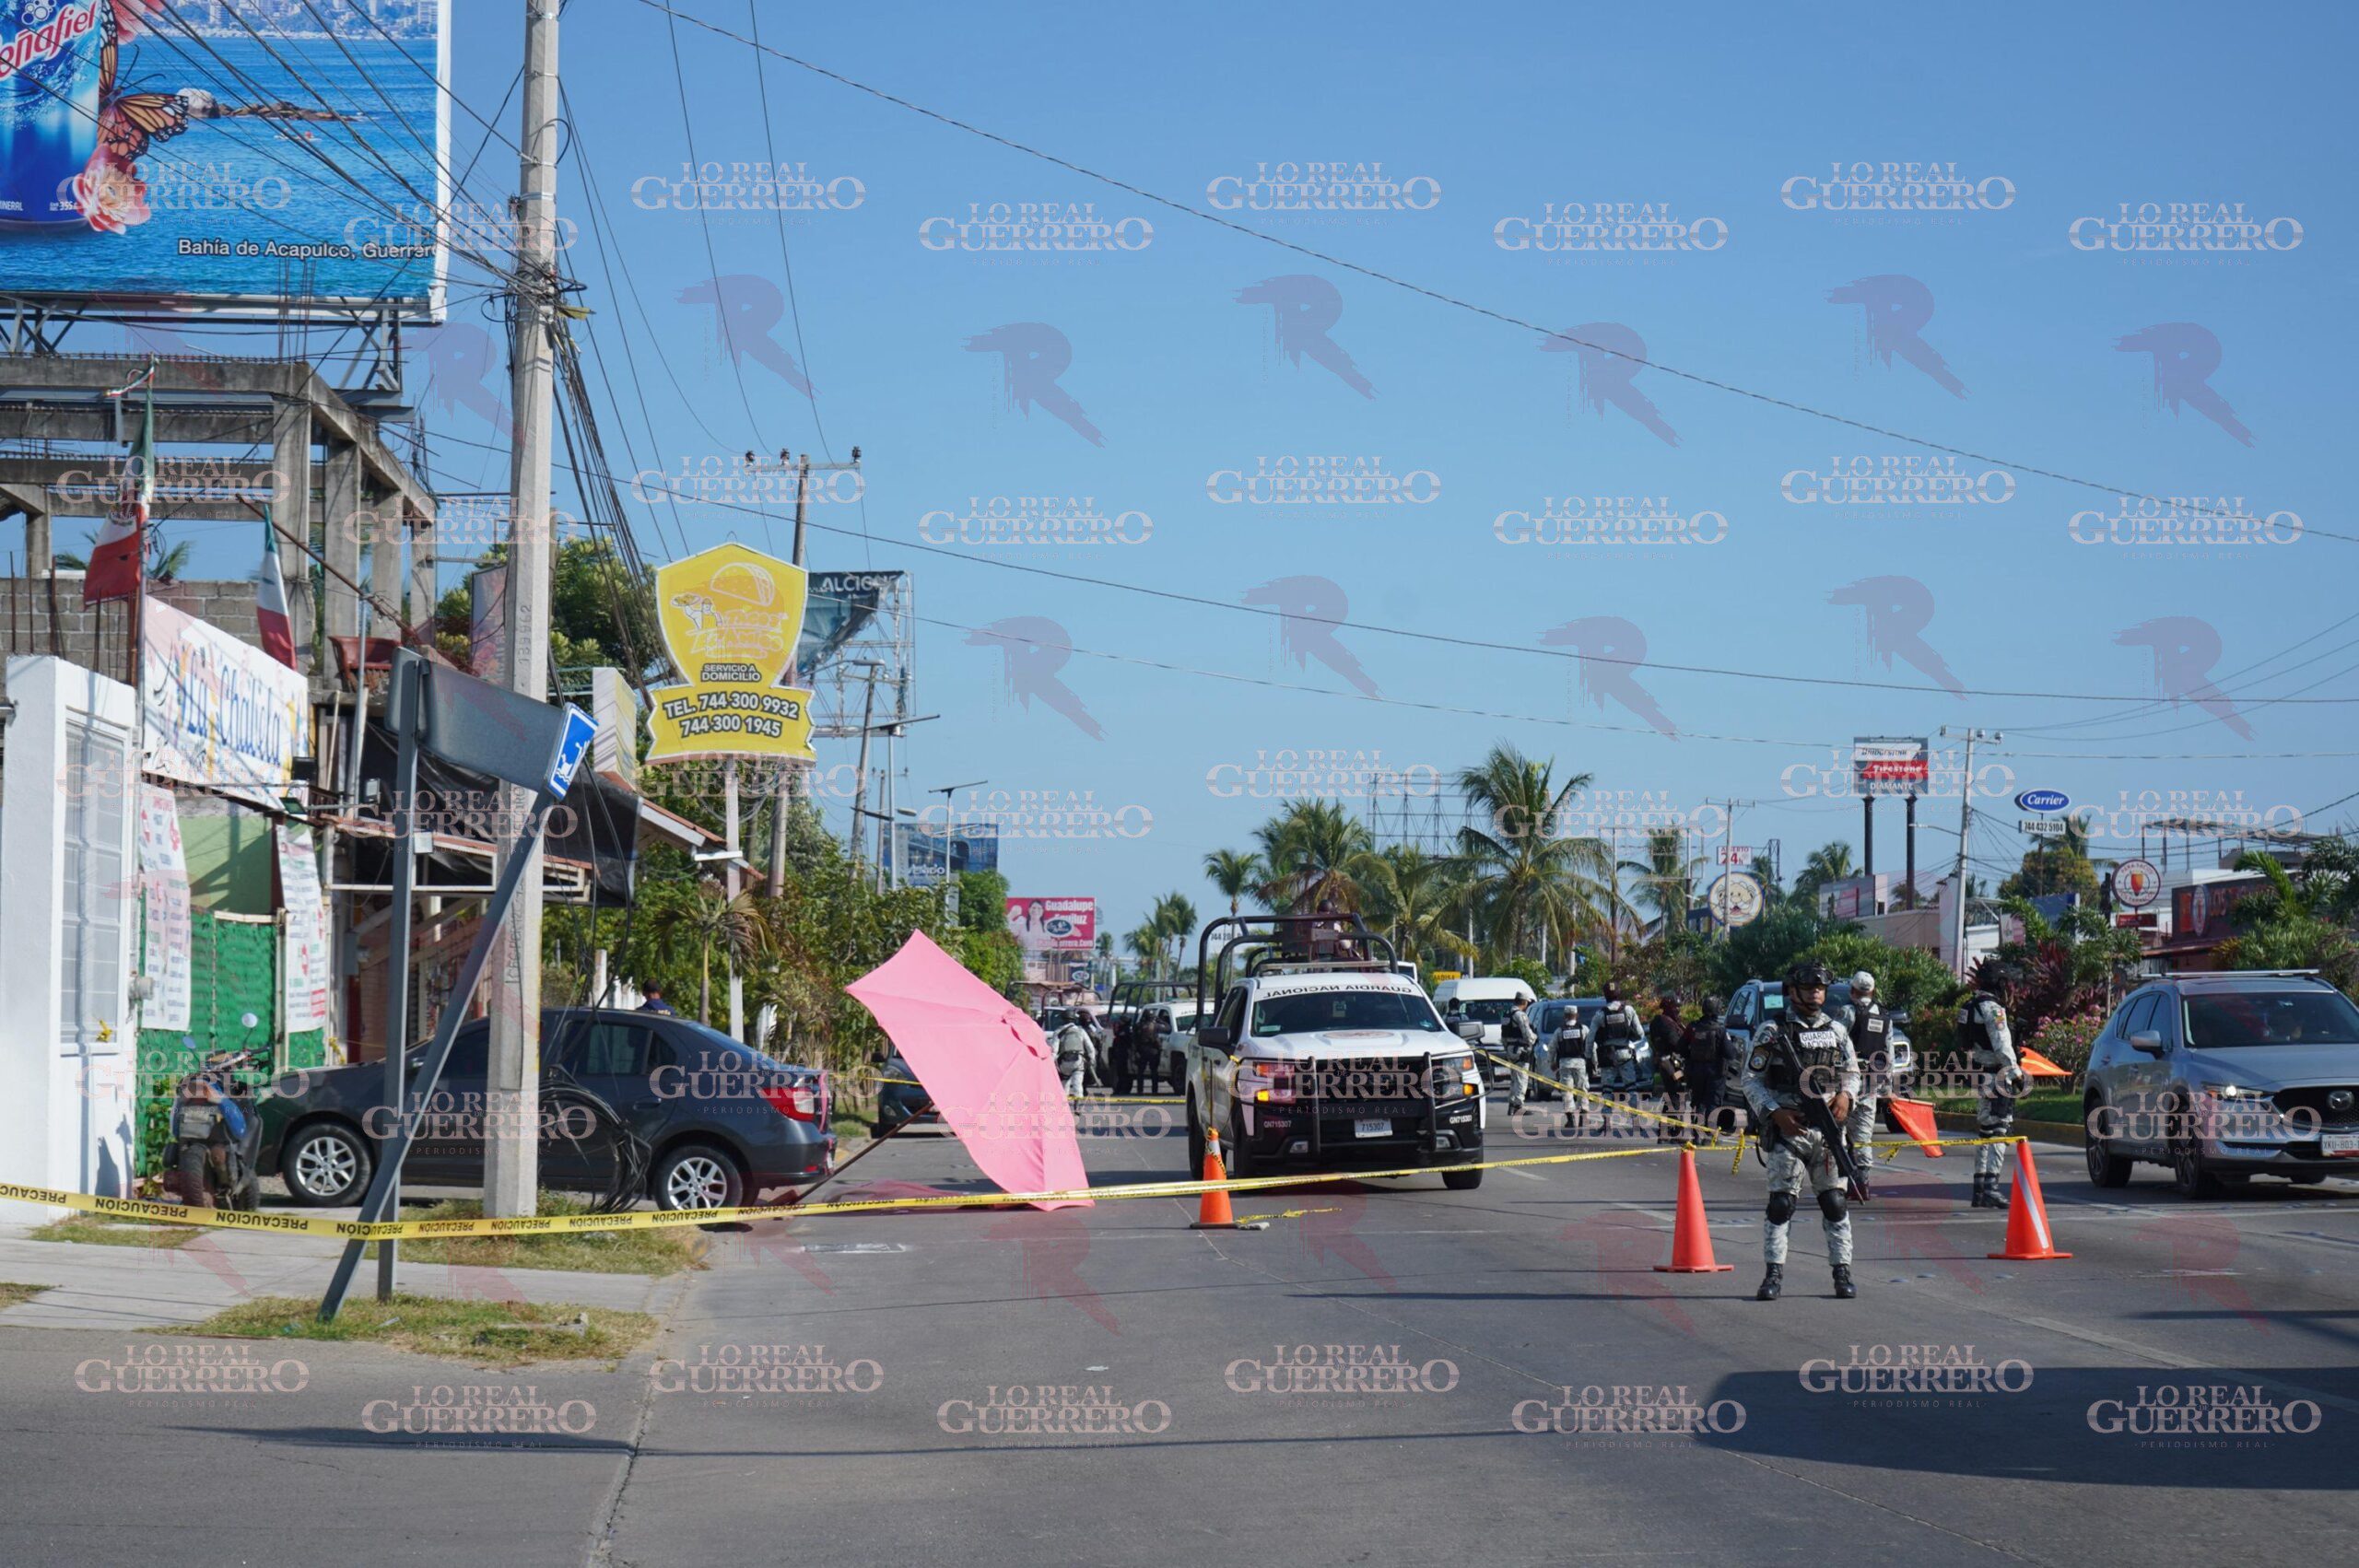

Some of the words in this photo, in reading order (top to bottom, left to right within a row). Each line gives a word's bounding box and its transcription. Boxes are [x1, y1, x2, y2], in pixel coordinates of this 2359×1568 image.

[0, 0, 97, 79] eñafiel
[178, 239, 230, 256] Bahía
[236, 240, 259, 256] de
[264, 241, 357, 260] Acapulco,
[703, 664, 746, 673] SERVICIO
[748, 664, 757, 673] A
[701, 672, 761, 682] DOMICILIO
[663, 700, 697, 719] TEL.
[762, 696, 799, 719] 9932
[745, 717, 781, 737] 1945
[2027, 794, 2065, 805] Carrier
[1045, 899, 1094, 912] Guadalupe
[0, 1185, 66, 1204] PRECAUC
[95, 1199, 188, 1219] PRECAUCIÓN
[216, 1211, 309, 1230] PRECAUCIÓN
[569, 1216, 633, 1229] PRECAUCIÓN
[651, 1210, 719, 1223] PRECAUCIÓN
[418, 1222, 475, 1235] PRECAUCIÓN
[490, 1219, 552, 1233] PRECAUCIÓN
